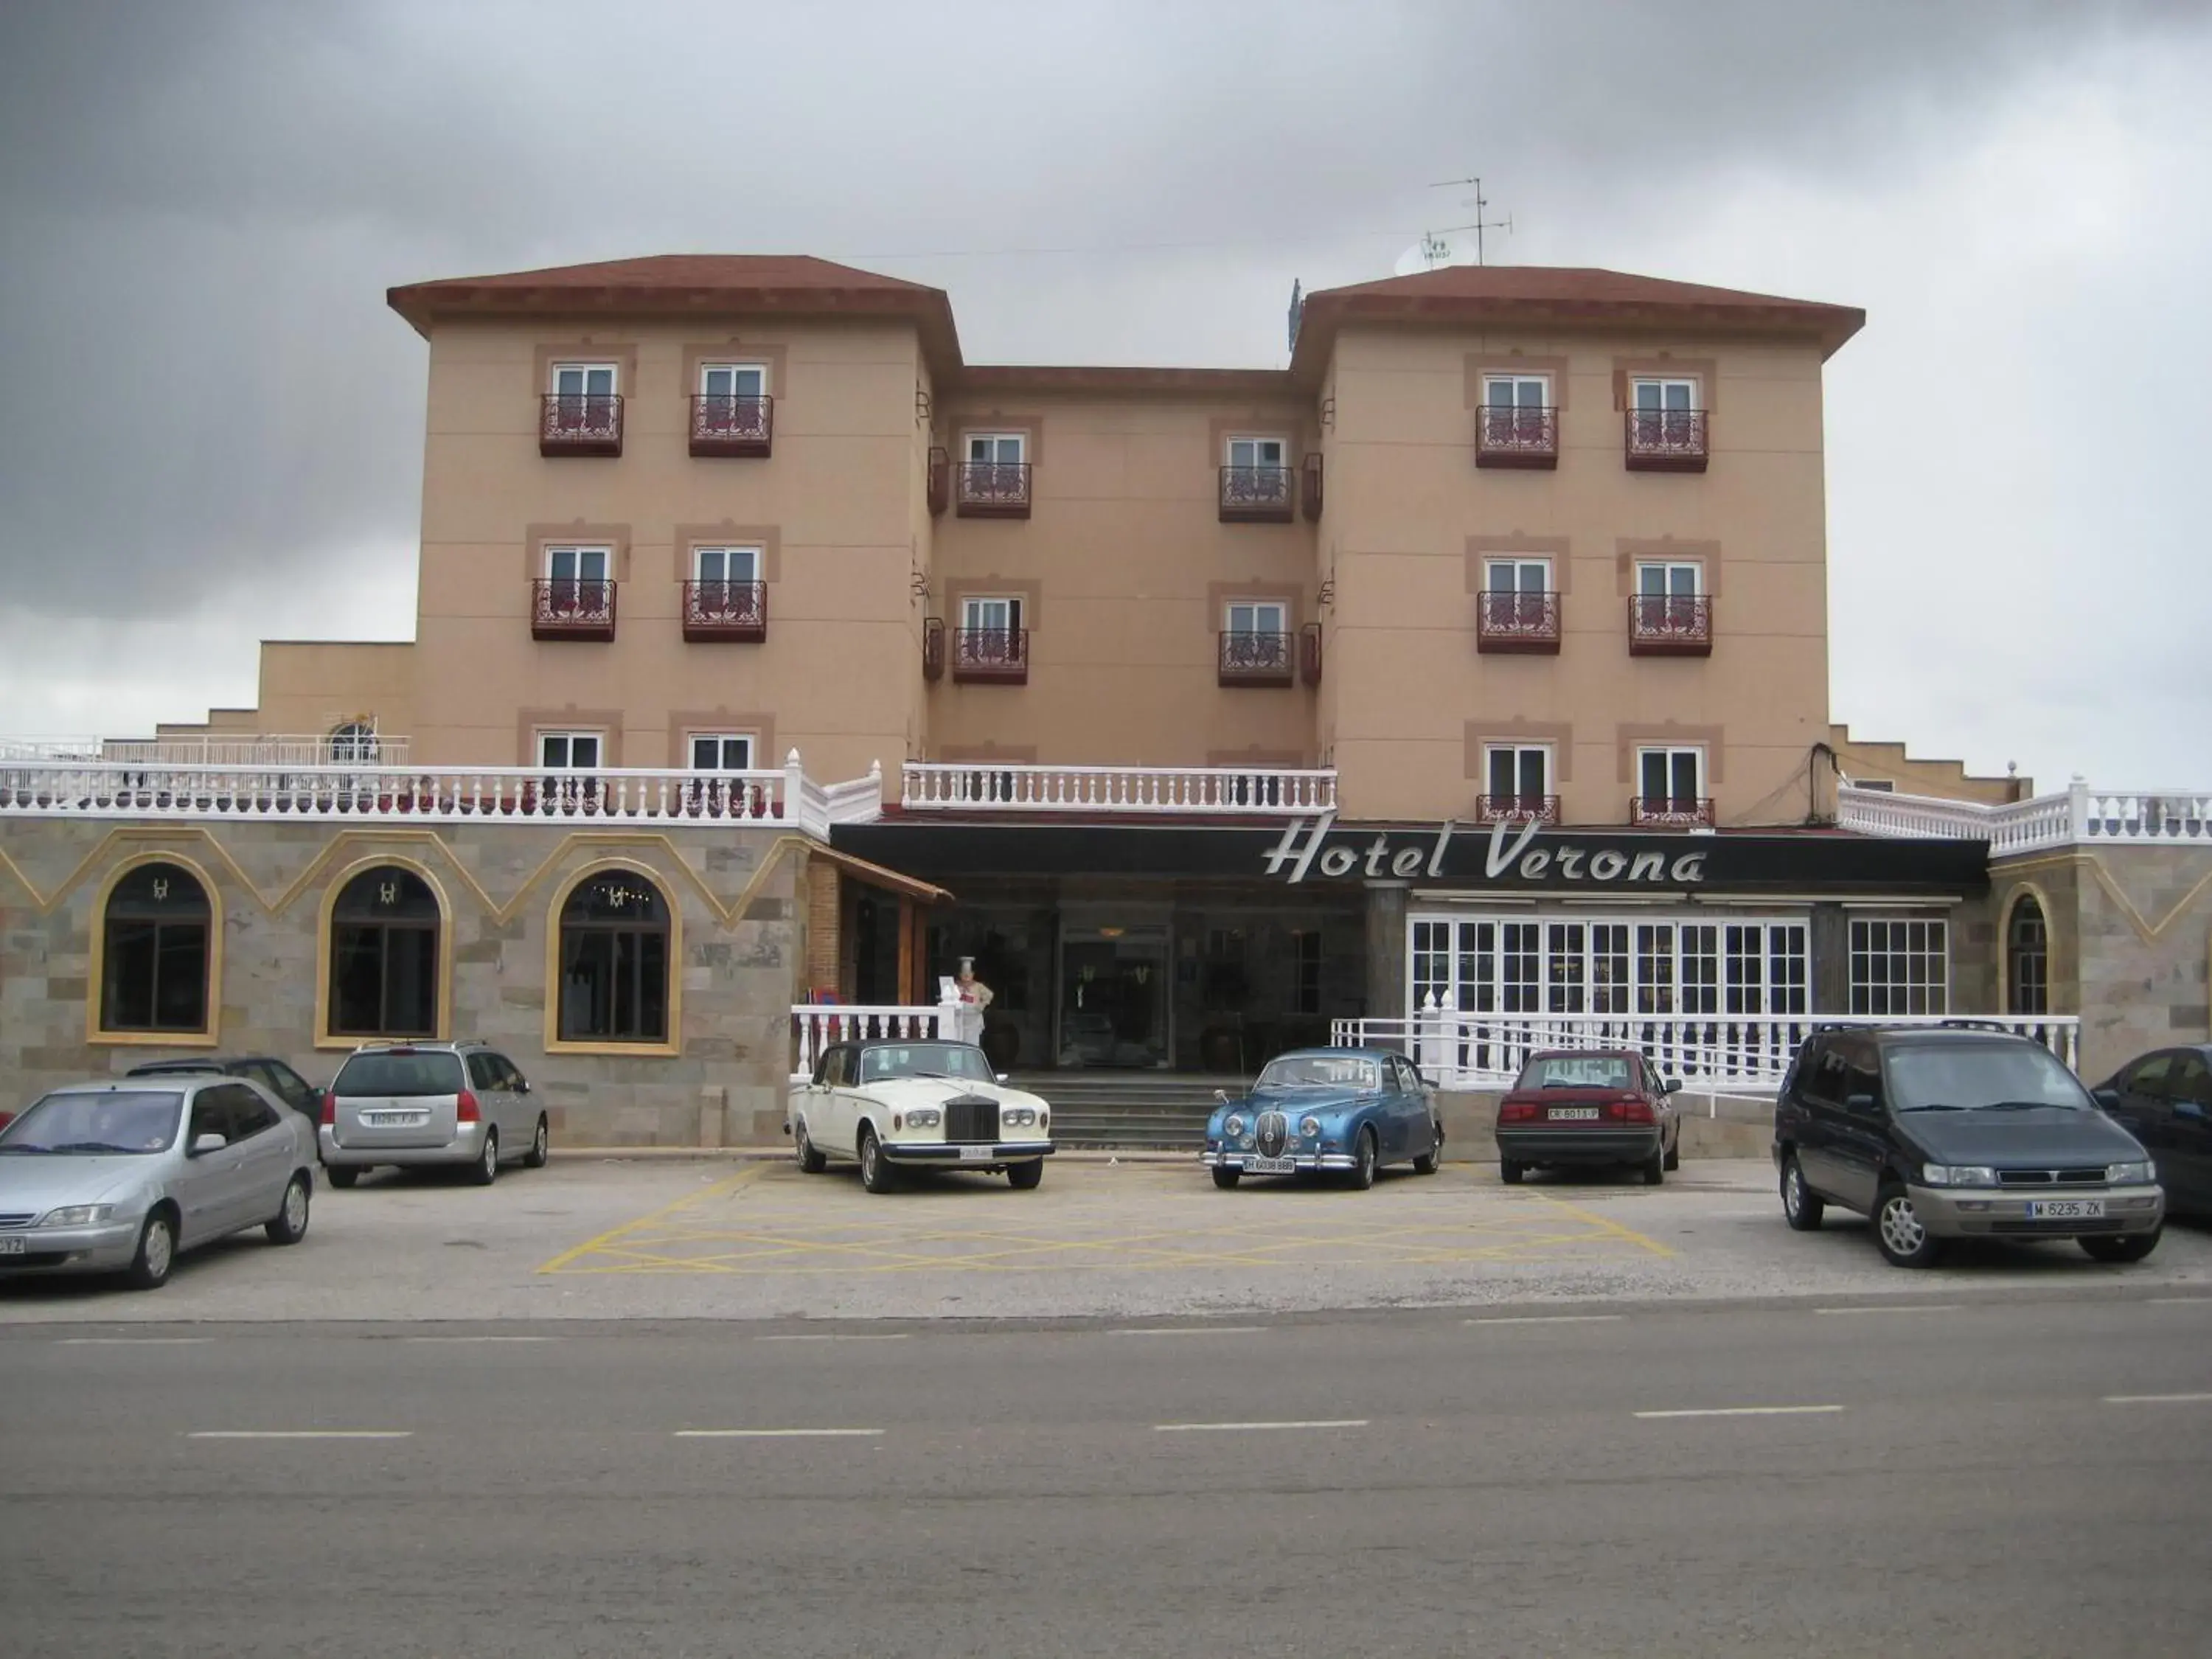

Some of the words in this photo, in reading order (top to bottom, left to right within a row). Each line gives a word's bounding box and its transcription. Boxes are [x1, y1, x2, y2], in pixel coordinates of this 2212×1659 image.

[1261, 811, 1457, 883] Hotel
[1486, 818, 1707, 881] Verona
[2048, 1203, 2080, 1216] 6235
